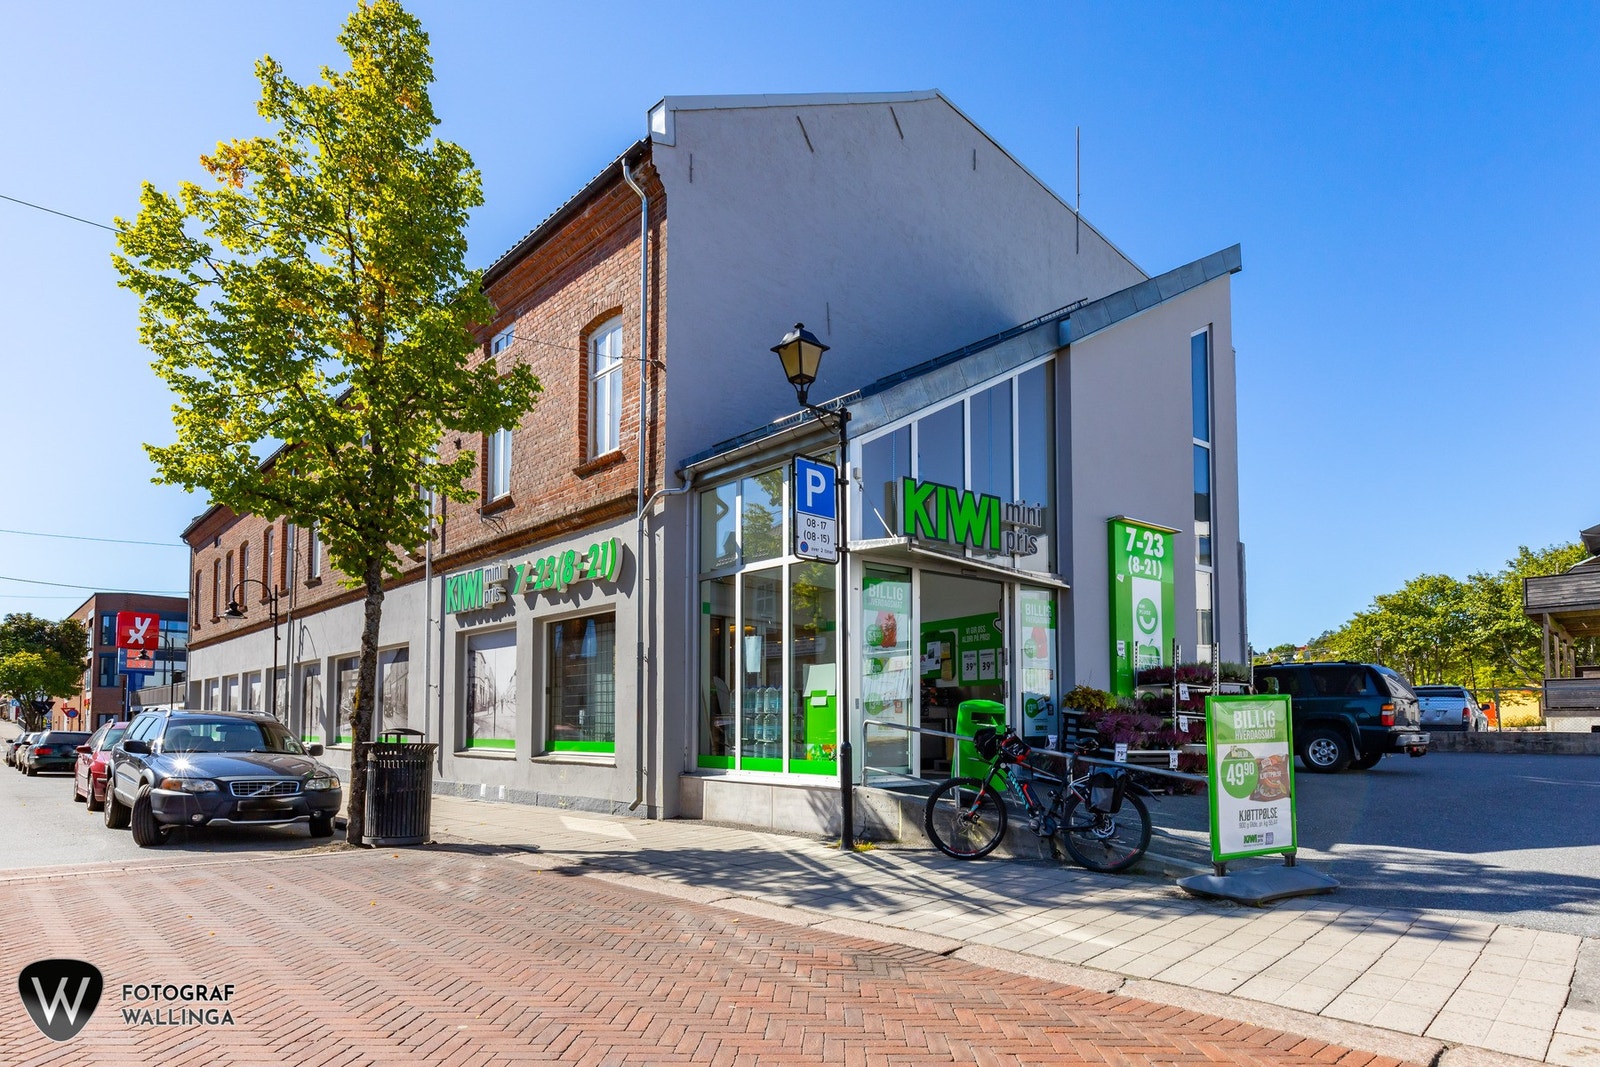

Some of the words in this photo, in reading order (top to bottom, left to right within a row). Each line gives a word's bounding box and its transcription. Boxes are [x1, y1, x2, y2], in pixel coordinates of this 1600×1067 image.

[806, 468, 826, 507] P
[902, 476, 1001, 550] KIWI
[1005, 500, 1041, 527] mini
[1005, 529, 1038, 556] pris
[1126, 526, 1164, 558] 7-23
[1128, 554, 1162, 580] (8-21)
[445, 568, 484, 614] KIWI
[484, 585, 501, 604] pris
[868, 583, 903, 601] BILLIG
[1233, 710, 1276, 729] BILLIG
[1238, 807, 1278, 821] KJØTTPØLSE
[1243, 834, 1257, 844] KIWI
